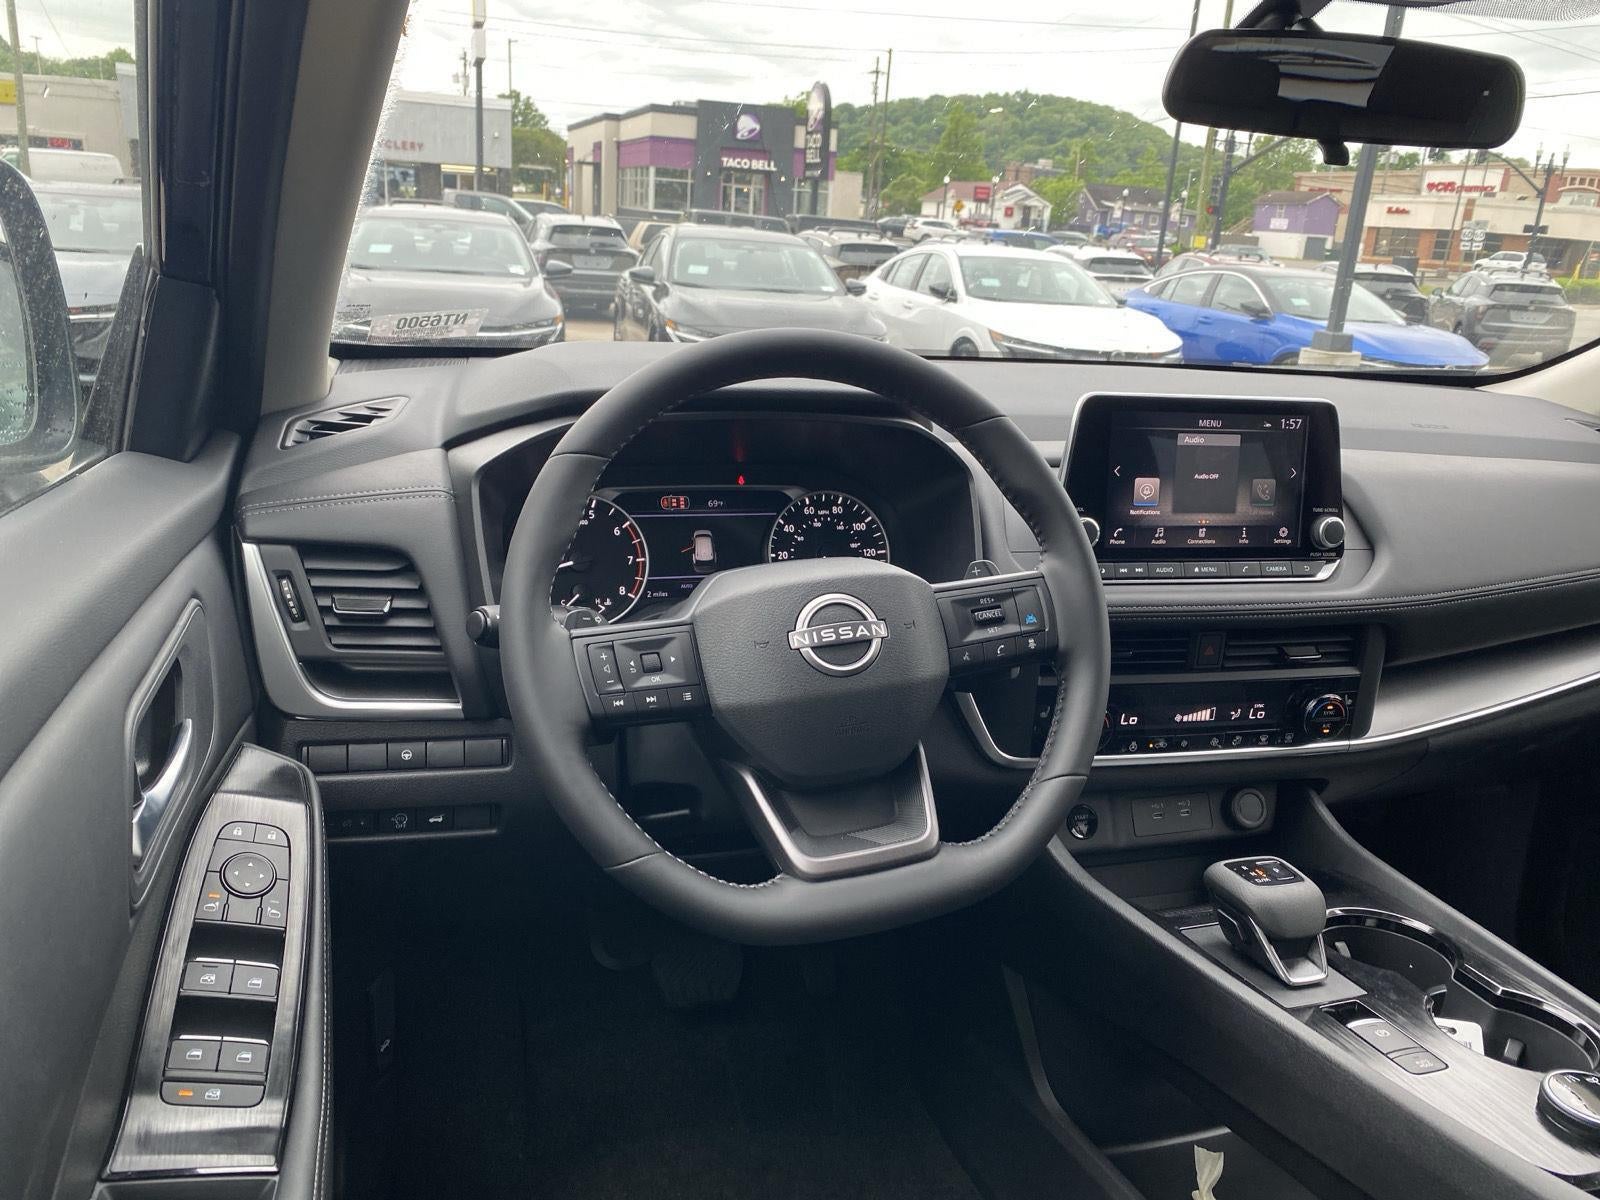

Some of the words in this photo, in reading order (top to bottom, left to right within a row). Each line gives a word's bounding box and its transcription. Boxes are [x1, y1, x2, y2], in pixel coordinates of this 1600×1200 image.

[721, 157, 750, 169] TACO
[751, 159, 777, 171] BELL
[1198, 419, 1222, 428] MENU
[1280, 418, 1302, 430] 1:57
[1183, 436, 1205, 444] Audio
[588, 510, 596, 519] 5
[803, 506, 815, 515] 60
[832, 506, 843, 515] 80
[613, 526, 621, 536] 6
[783, 524, 795, 533] 40
[852, 523, 867, 531] 100
[777, 551, 789, 560] 20
[862, 548, 876, 557] 120
[627, 556, 633, 565] 7
[1155, 566, 1174, 574] AUDIO
[619, 586, 626, 595] 8
[978, 610, 1002, 620] CANCEL
[792, 622, 885, 648] NISSAN
[650, 675, 661, 683] OK
[1249, 708, 1265, 720] Lo
[1120, 713, 1138, 726] Lo
